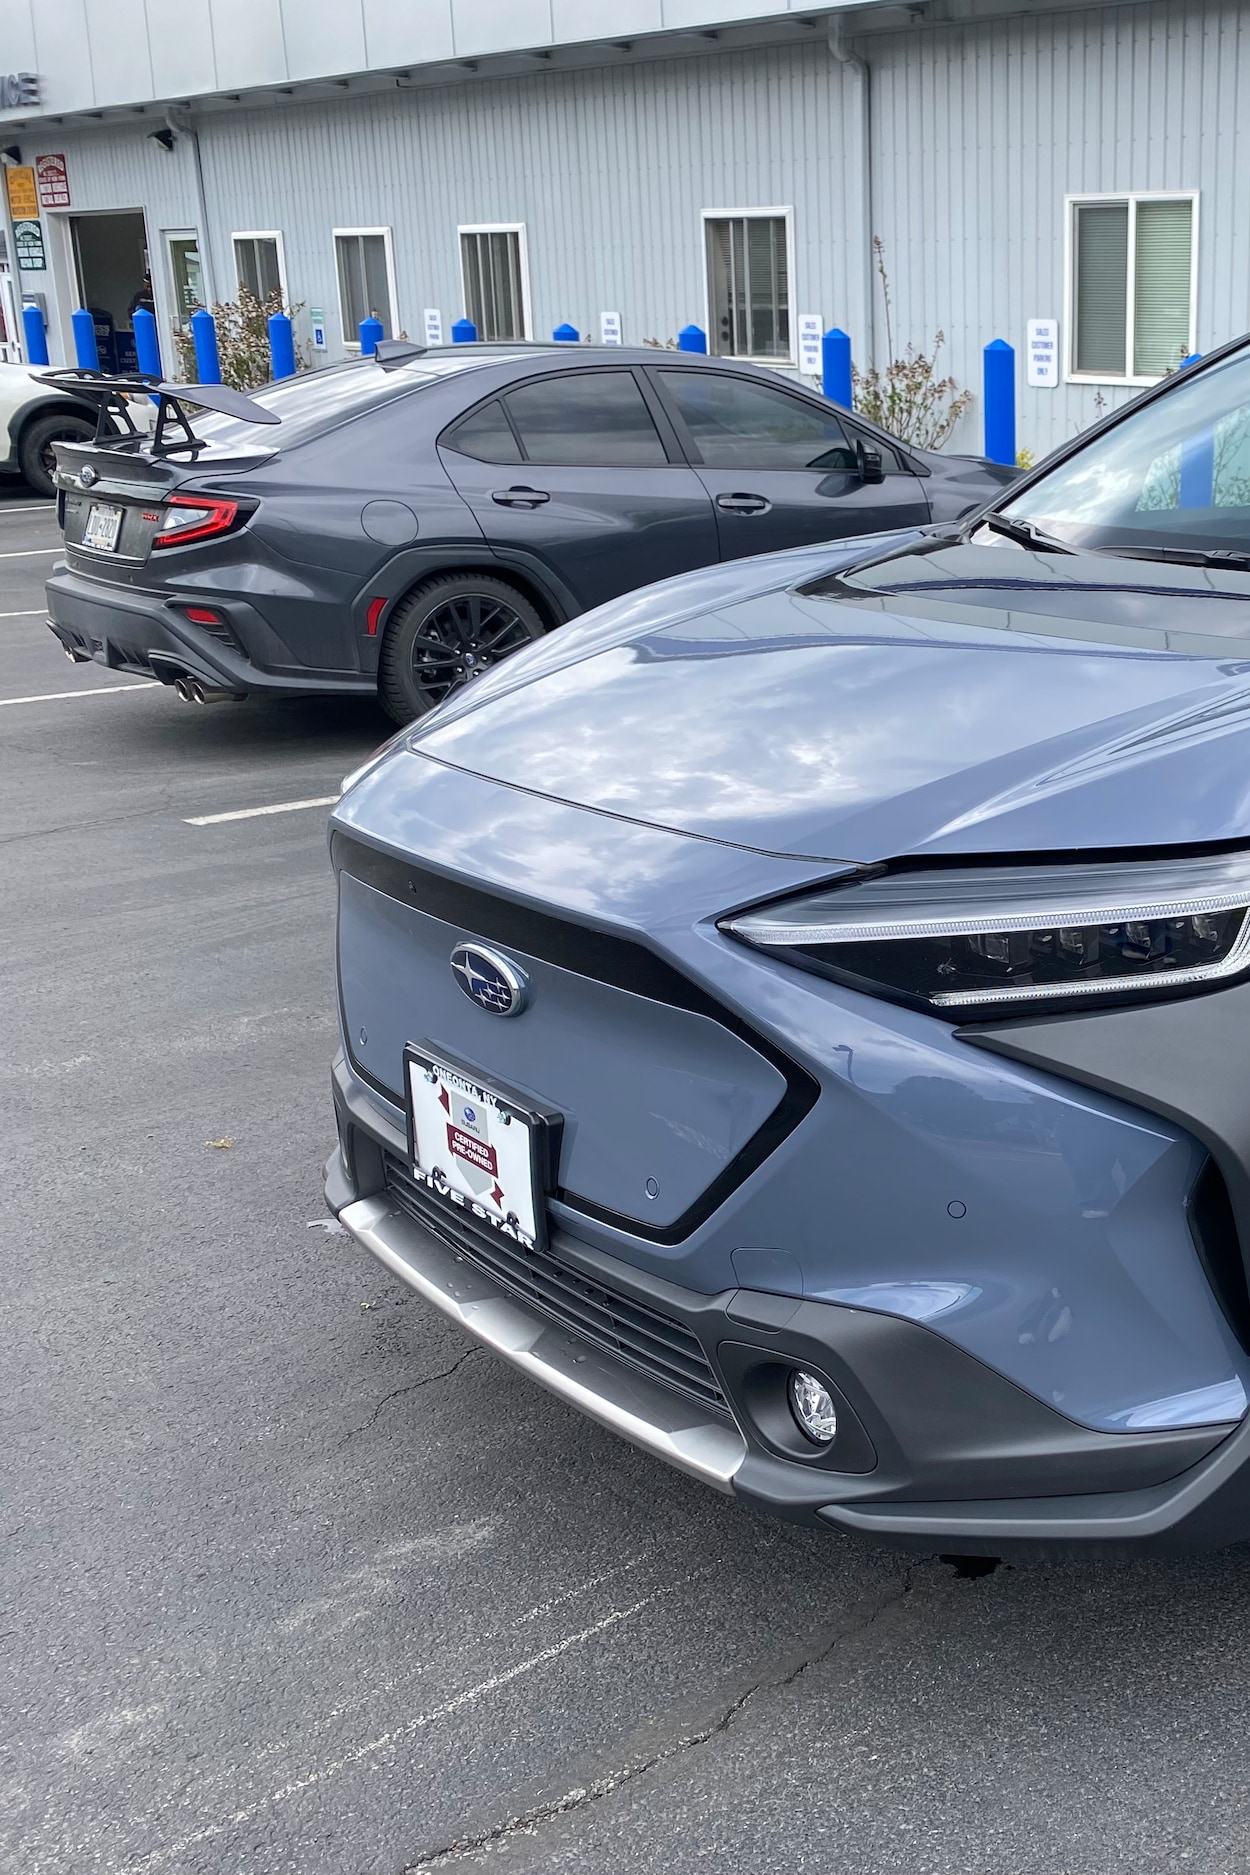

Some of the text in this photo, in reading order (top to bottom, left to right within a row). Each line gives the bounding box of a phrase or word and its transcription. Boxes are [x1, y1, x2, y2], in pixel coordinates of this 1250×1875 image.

[483, 1092, 498, 1107] NY
[461, 1119, 480, 1134] SUBARU
[451, 1140, 493, 1171] PRE-OWNED
[454, 1131, 489, 1157] CERTIFIED
[413, 1168, 535, 1251] FIVE STAR
